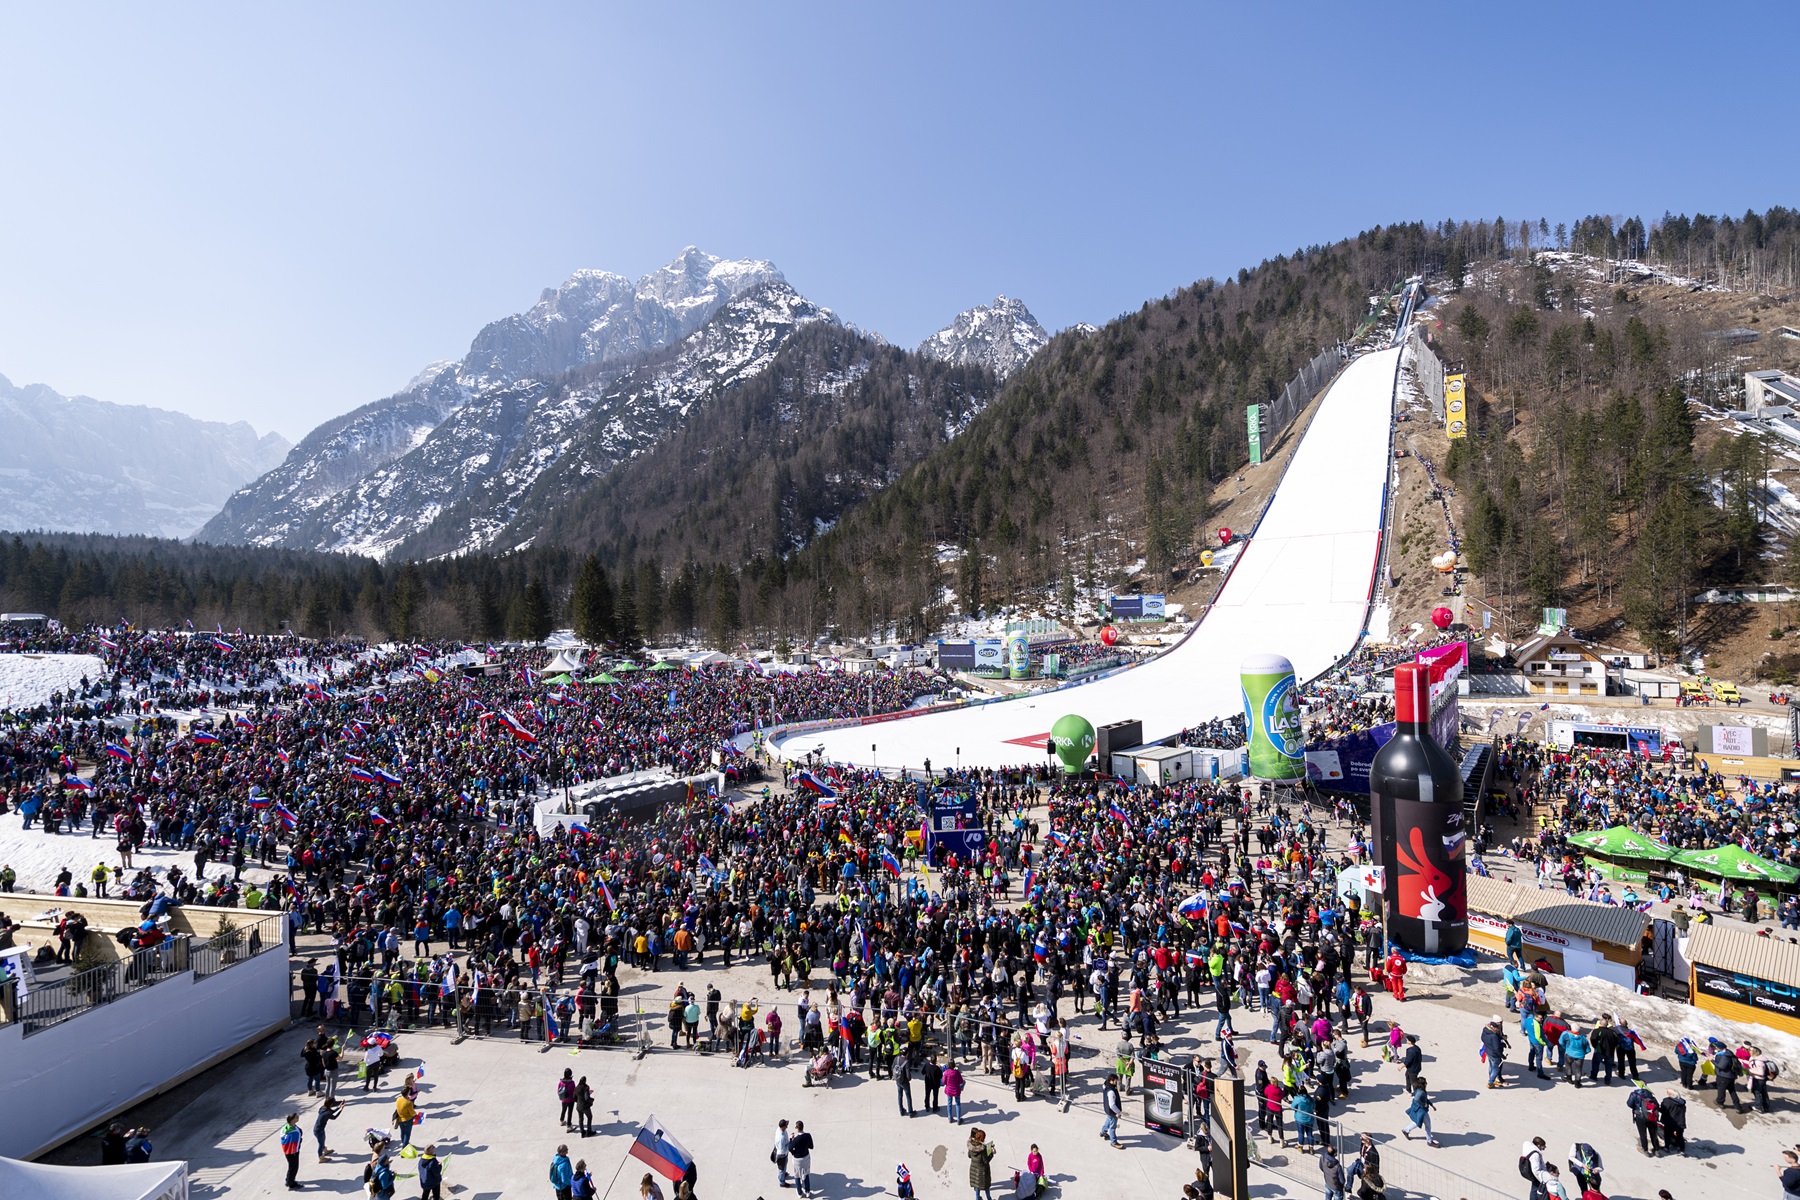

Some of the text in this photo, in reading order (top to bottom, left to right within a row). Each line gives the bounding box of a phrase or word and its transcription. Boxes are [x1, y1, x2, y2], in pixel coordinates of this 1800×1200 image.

[1249, 412, 1258, 434] KRKA
[980, 648, 997, 657] derby
[1052, 735, 1075, 747] KRKA
[1705, 982, 1740, 996] PLANICA
